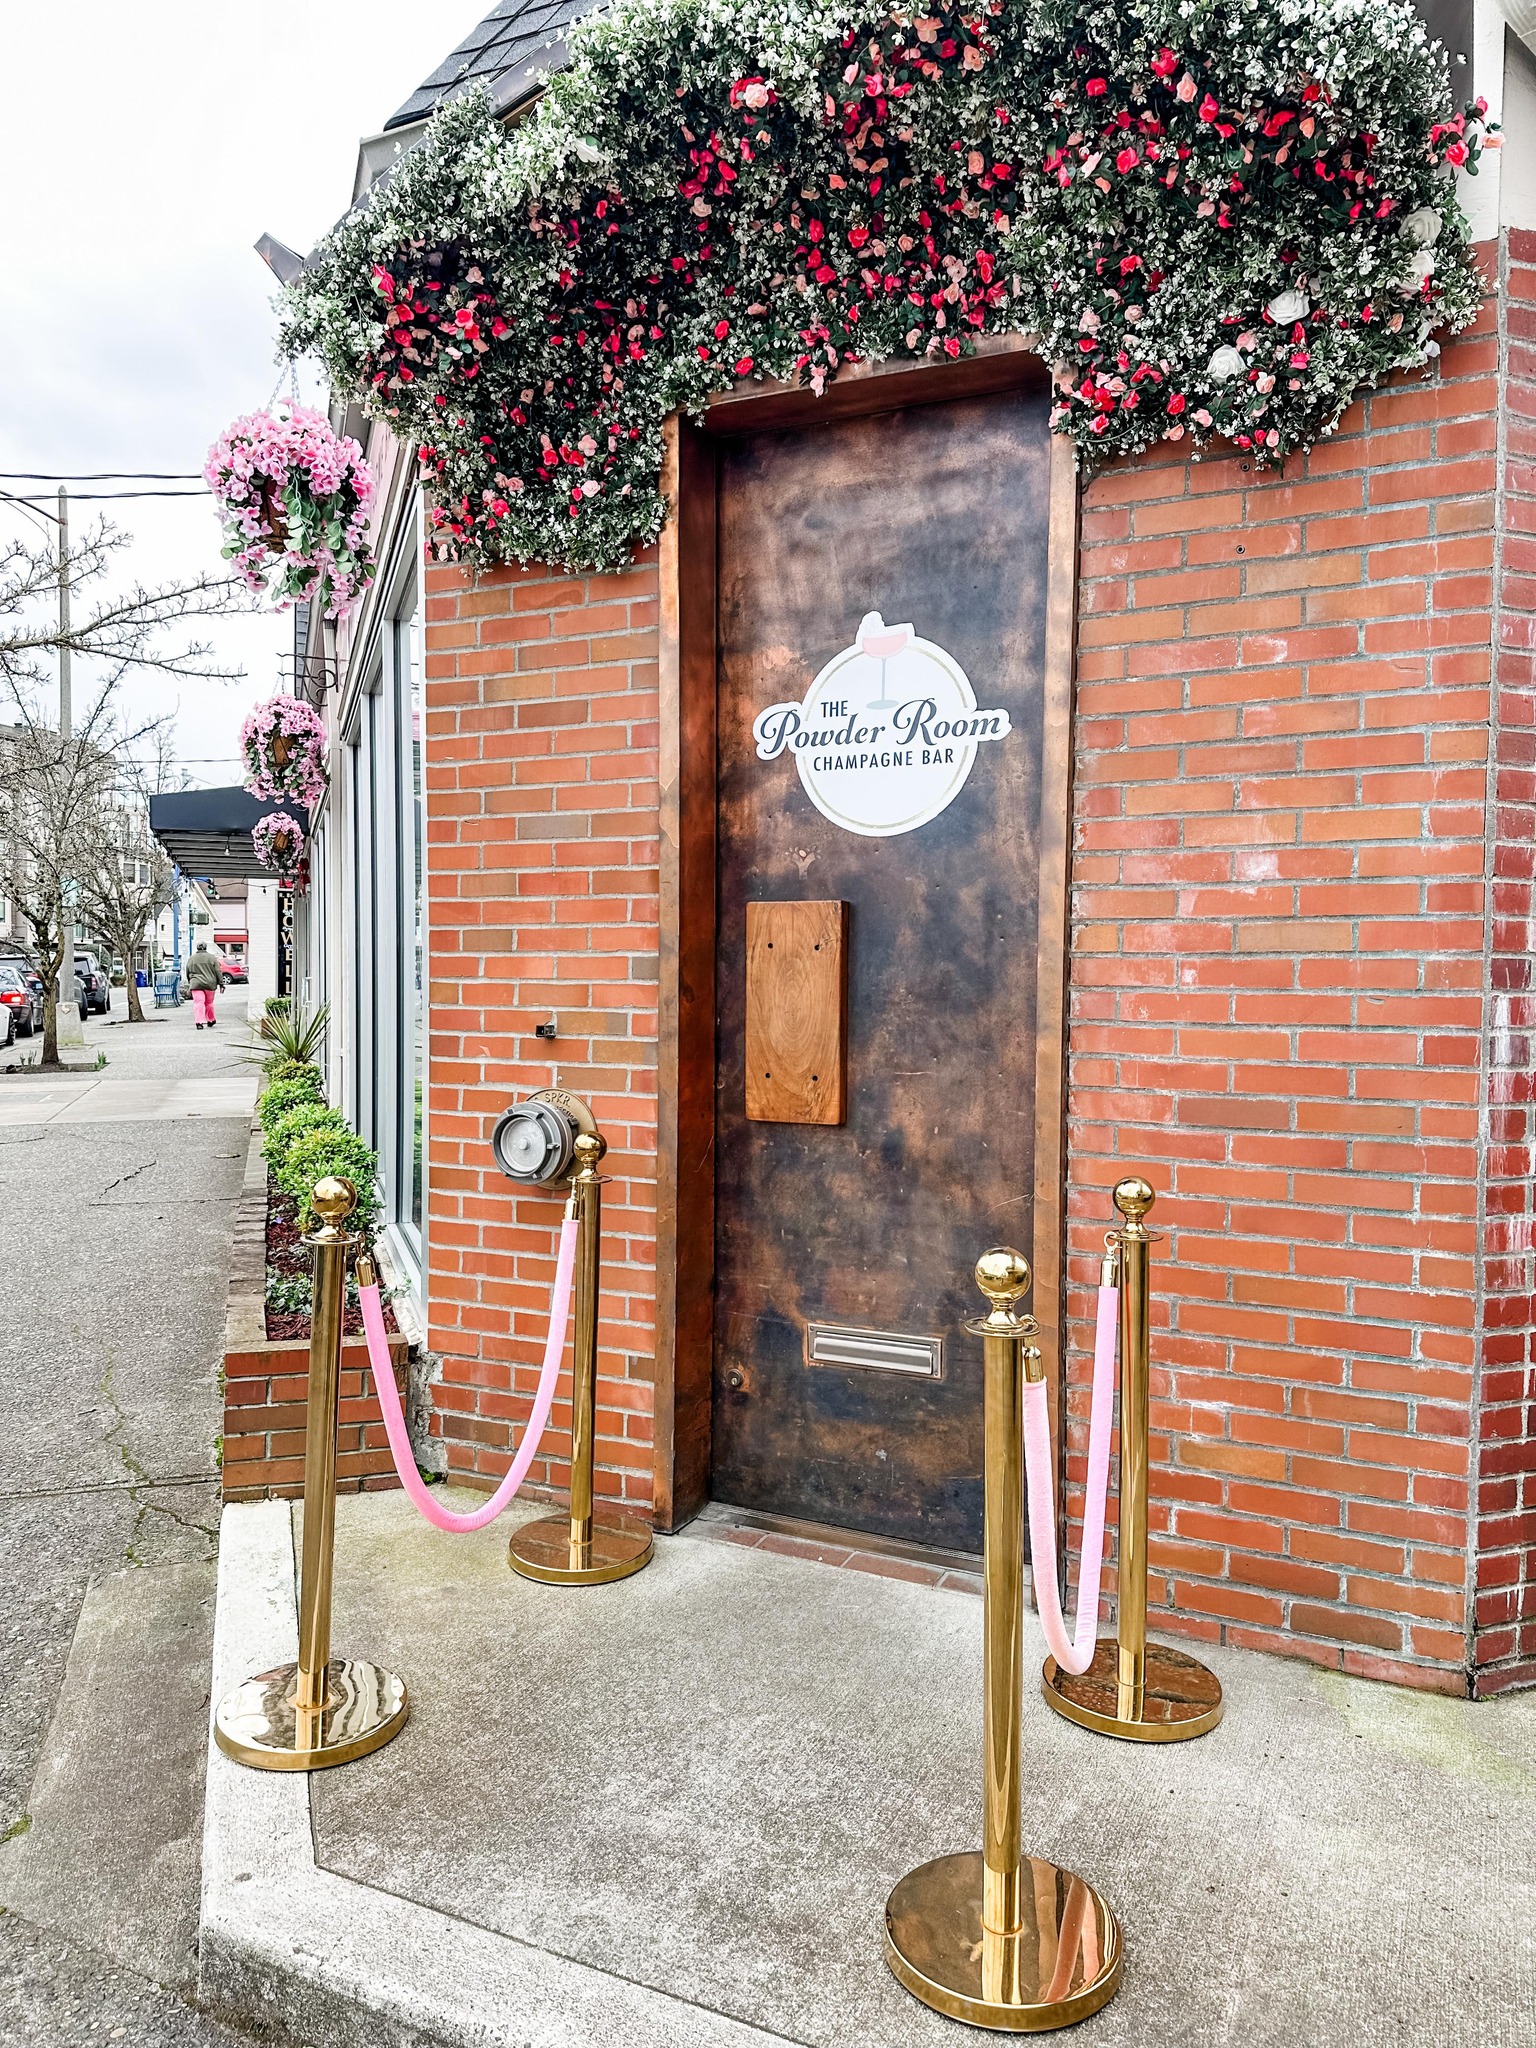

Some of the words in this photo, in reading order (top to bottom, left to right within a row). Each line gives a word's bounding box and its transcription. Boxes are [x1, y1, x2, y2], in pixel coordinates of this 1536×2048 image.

[821, 701, 849, 718] THE
[760, 709, 886, 754] Powder
[892, 698, 1002, 746] Room
[813, 751, 913, 771] CHAMPAGNE
[922, 748, 954, 765] BAR
